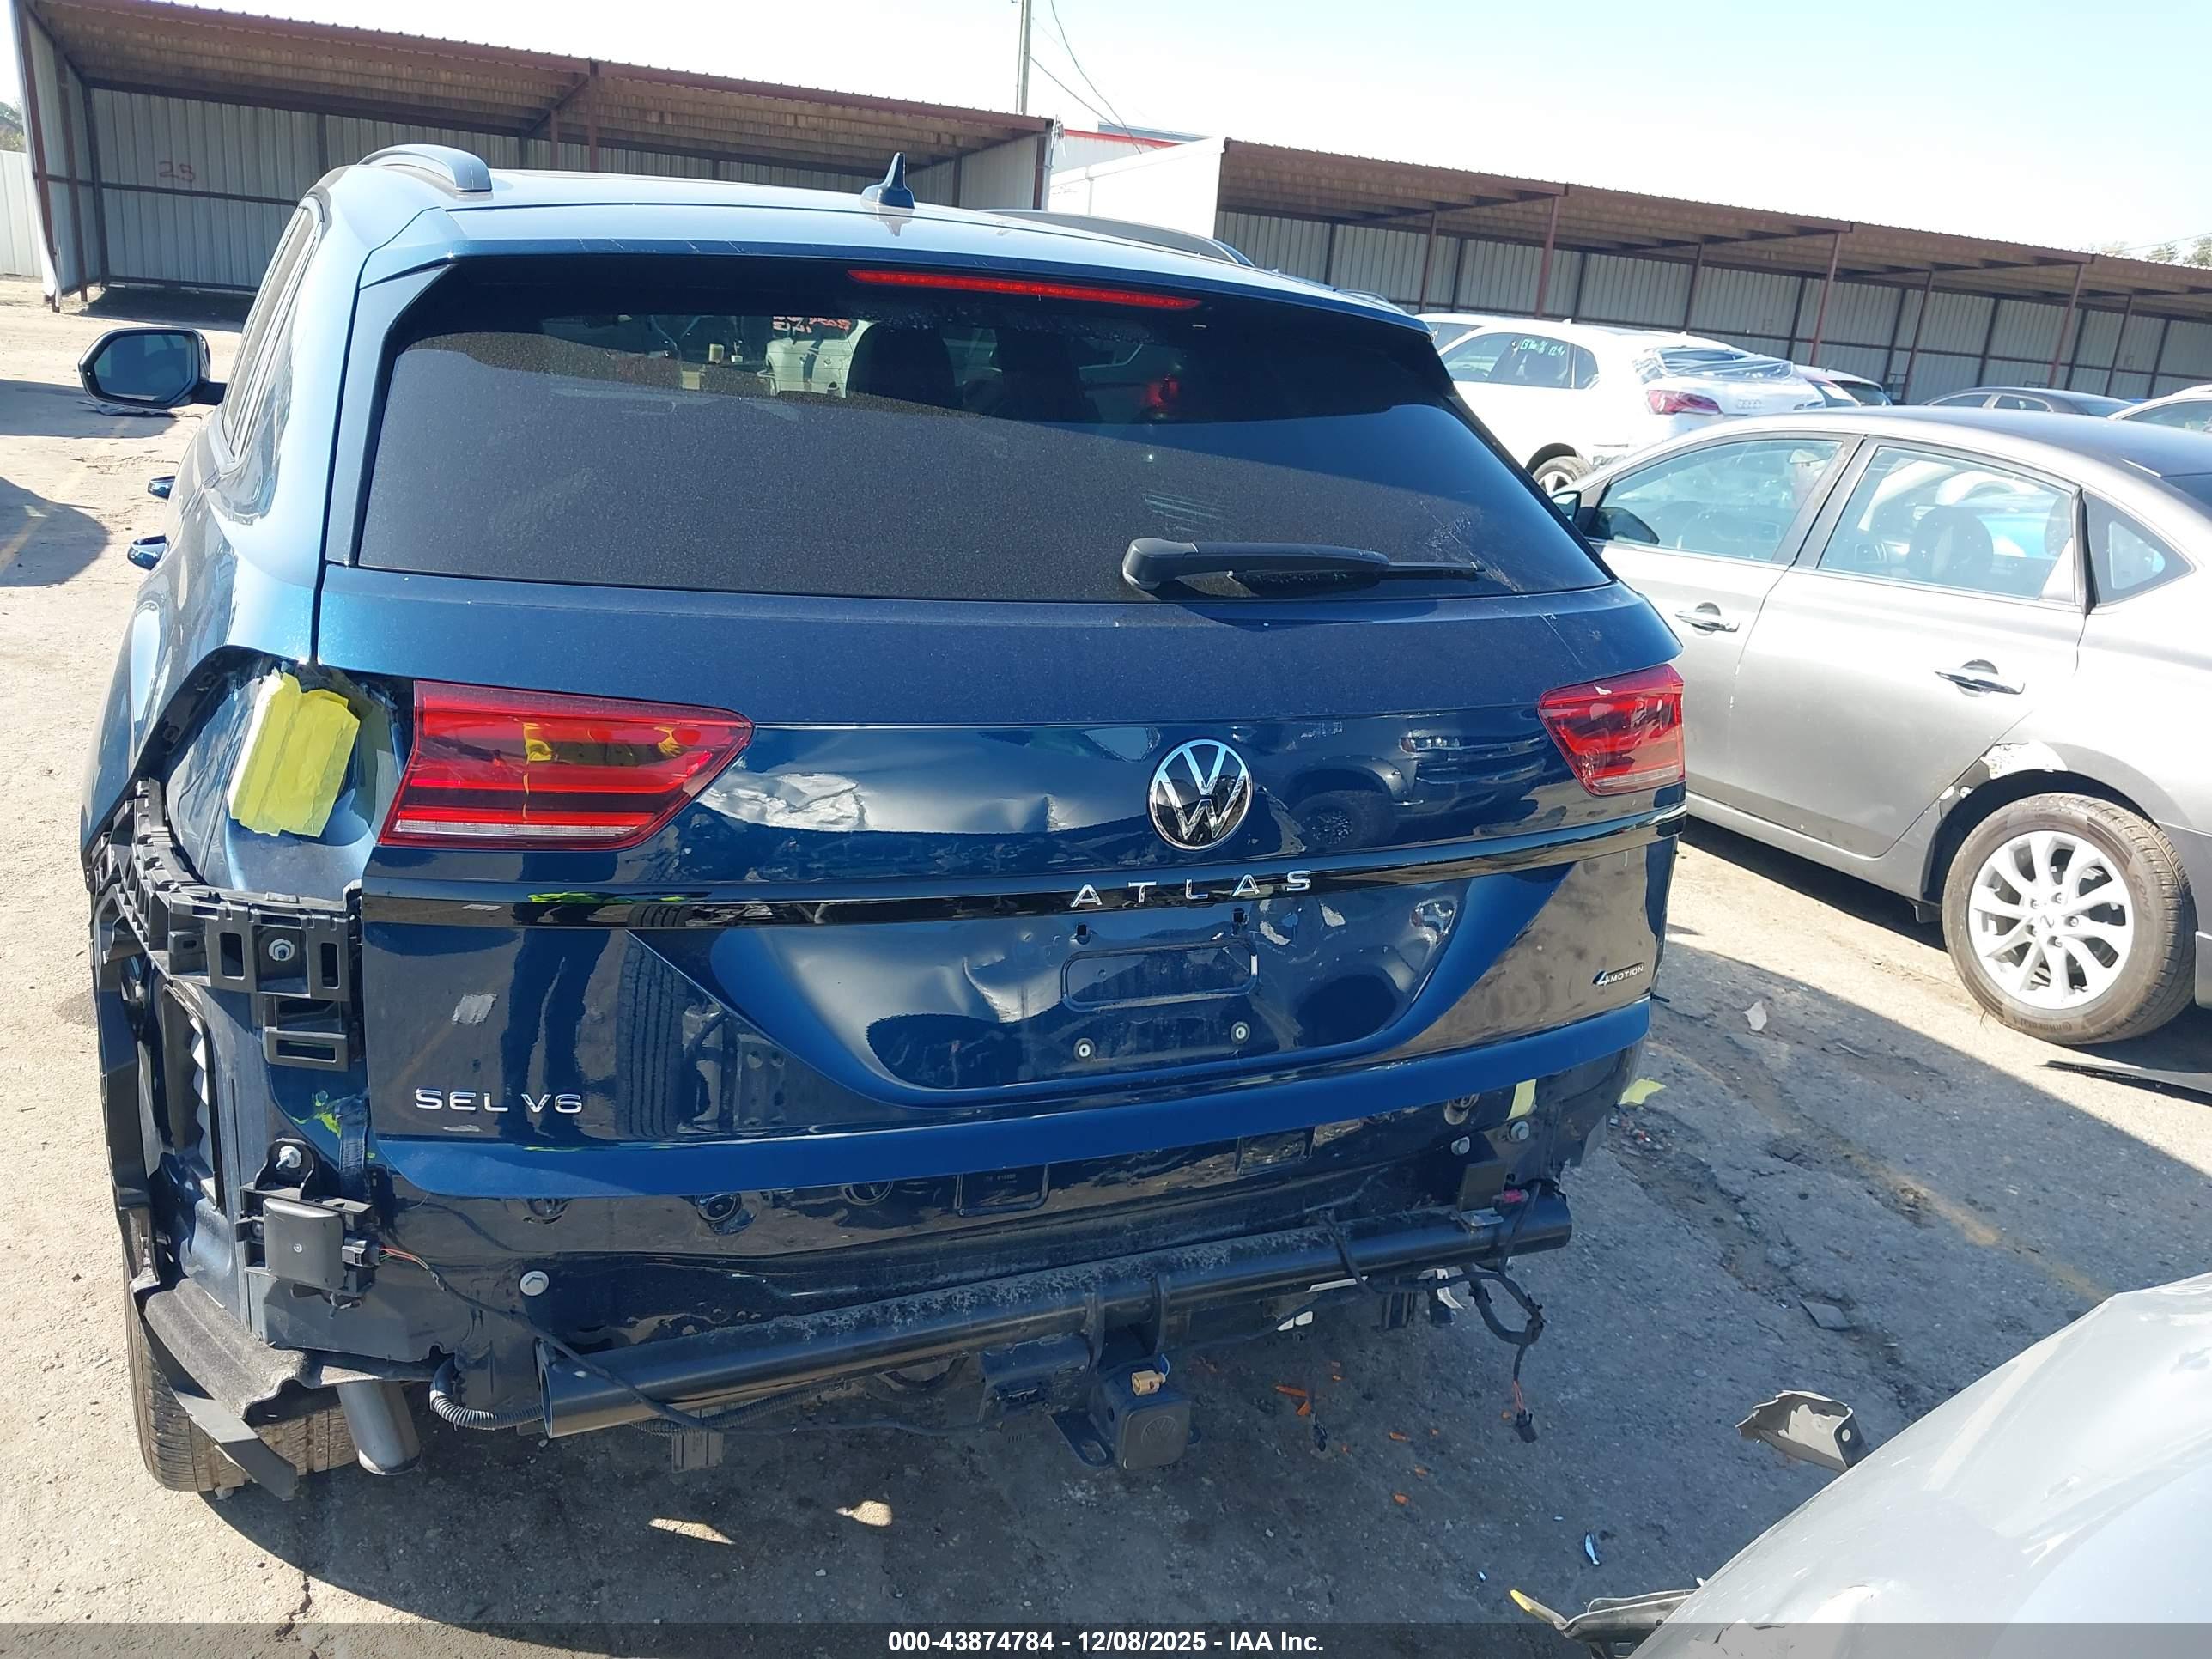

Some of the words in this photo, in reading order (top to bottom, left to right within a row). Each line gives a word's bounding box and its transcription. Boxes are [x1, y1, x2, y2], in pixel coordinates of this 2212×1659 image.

[1069, 869, 1312, 908] ATLAS
[1595, 964, 1644, 988] 4MOTION
[415, 1087, 509, 1113] SEL
[520, 1093, 583, 1115] V6
